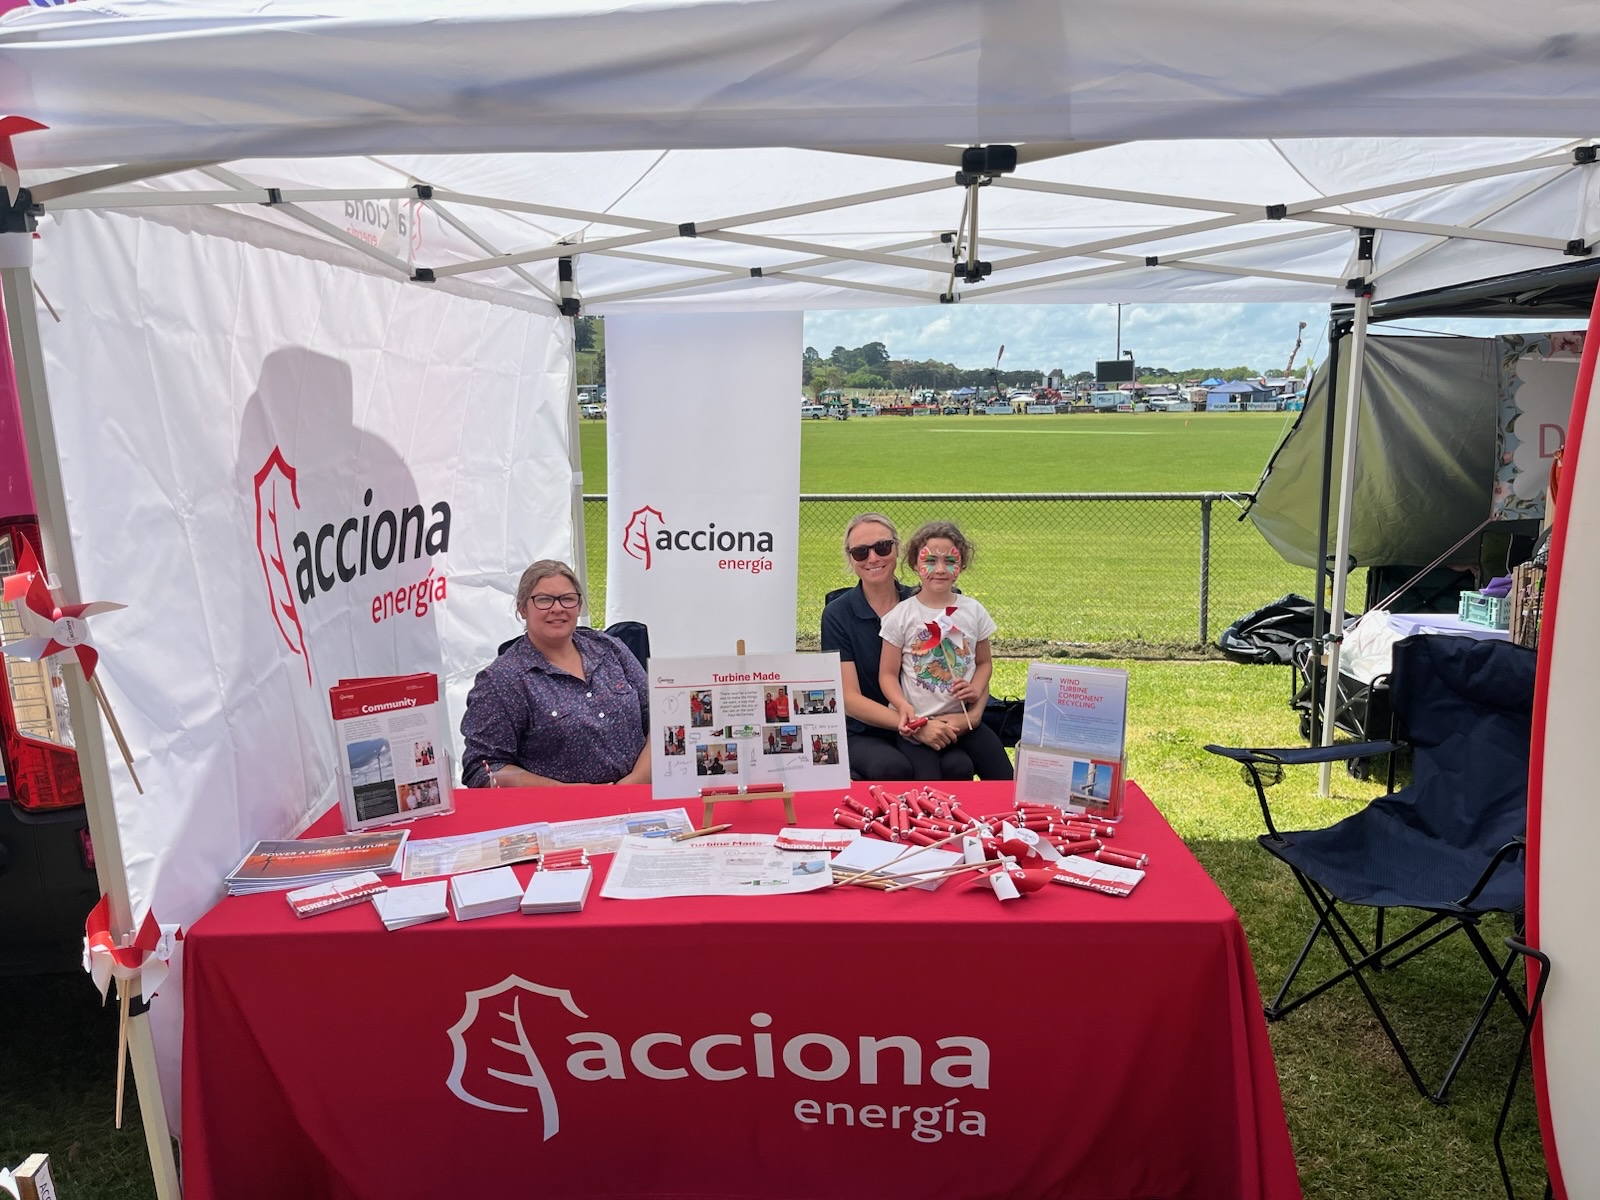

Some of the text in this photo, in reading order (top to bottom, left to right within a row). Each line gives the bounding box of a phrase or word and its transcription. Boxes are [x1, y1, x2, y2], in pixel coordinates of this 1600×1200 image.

[293, 488, 451, 604] acciona
[656, 522, 774, 552] acciona
[718, 556, 773, 574] energía
[372, 567, 446, 624] energía
[712, 672, 780, 683] Turbine Made
[1058, 692, 1104, 702] COMPONENT
[1060, 685, 1088, 694] TURBINE
[362, 698, 417, 713] Community
[1058, 699, 1096, 709] RECYCLING
[566, 1012, 991, 1090] acciona
[794, 1097, 987, 1143] energía
